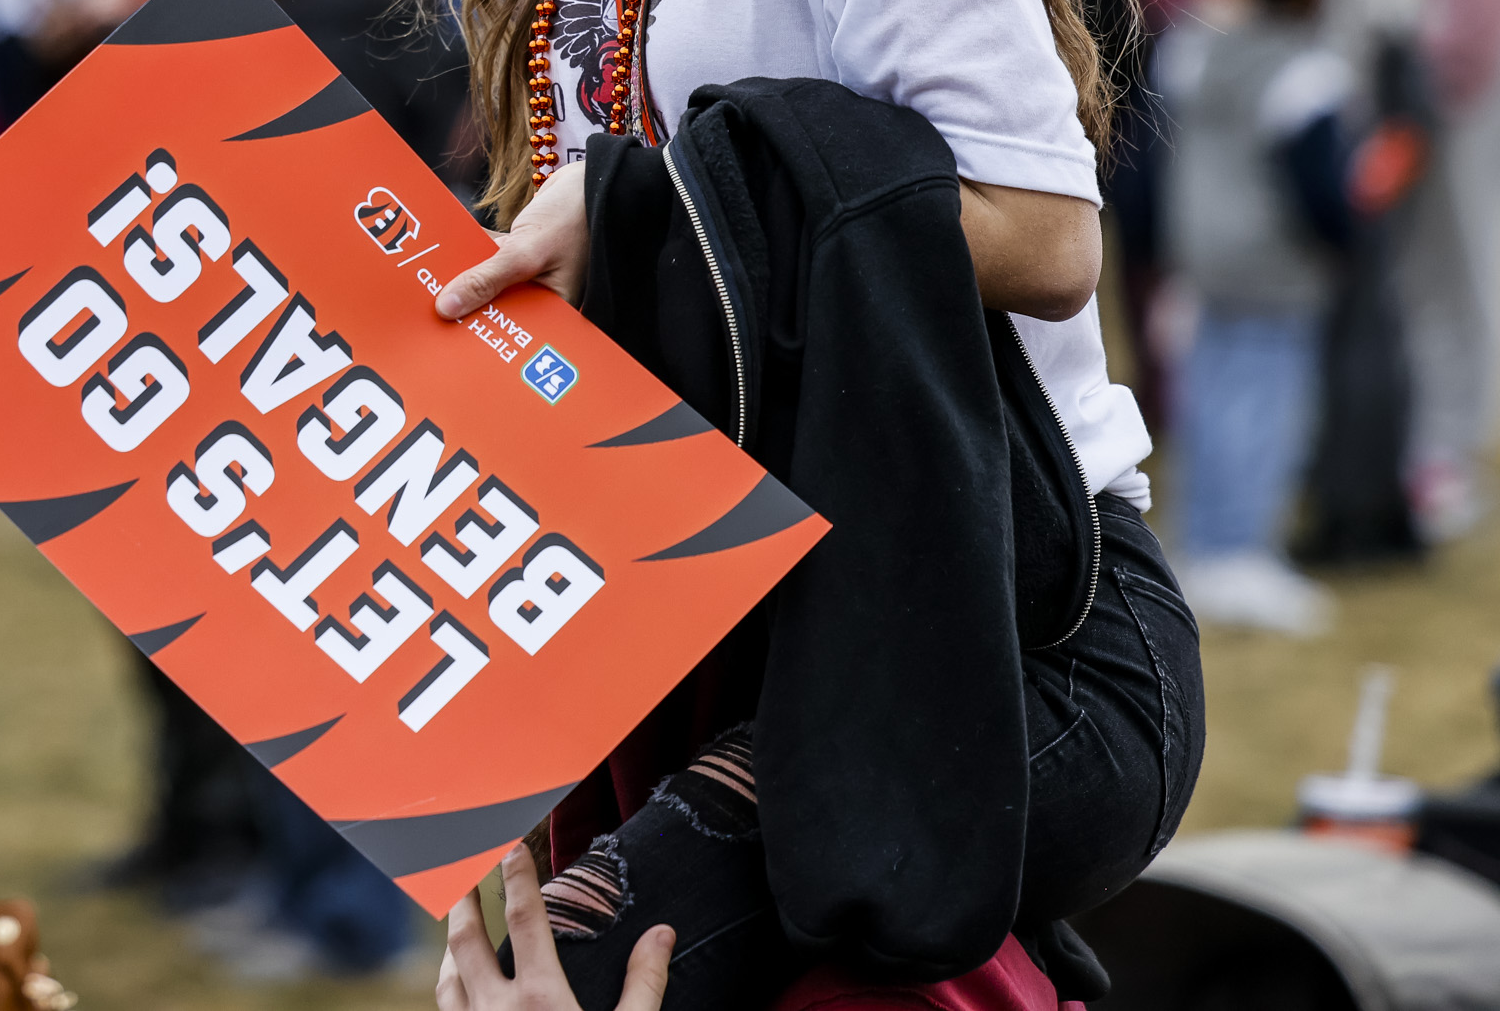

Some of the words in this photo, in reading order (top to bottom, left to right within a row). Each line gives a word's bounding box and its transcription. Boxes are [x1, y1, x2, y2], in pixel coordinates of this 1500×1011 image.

[18, 267, 190, 452] GO
[87, 149, 606, 656] BENGALS!
[467, 319, 519, 364] FIFTH
[482, 304, 534, 349] BANK
[167, 421, 489, 733] LET'S
